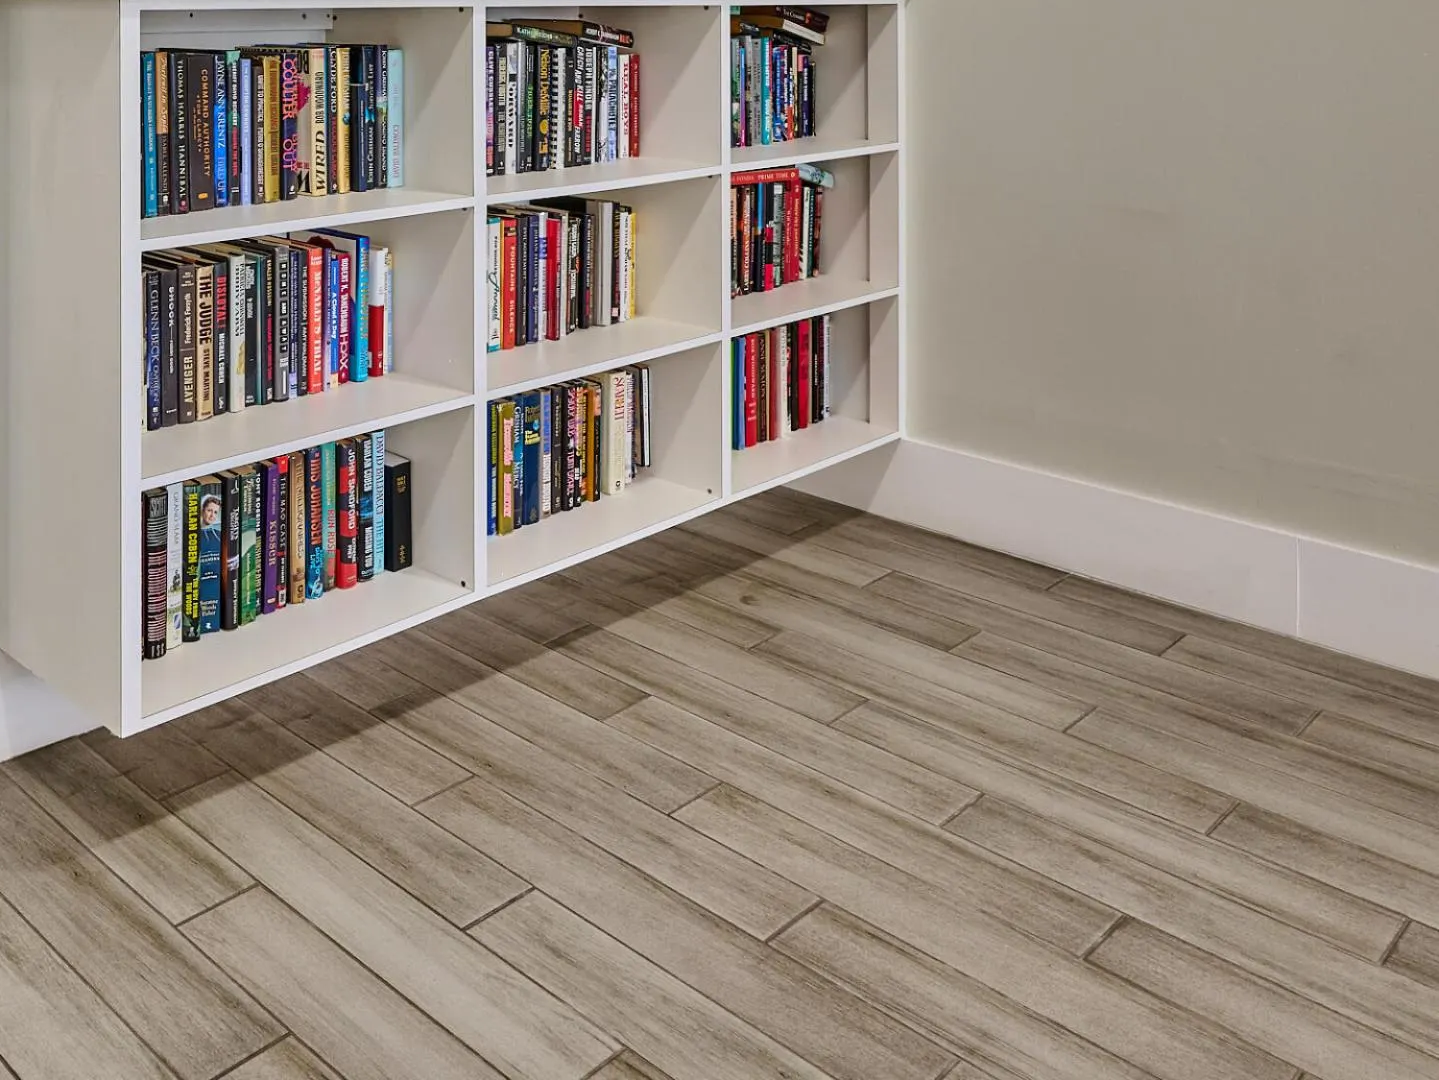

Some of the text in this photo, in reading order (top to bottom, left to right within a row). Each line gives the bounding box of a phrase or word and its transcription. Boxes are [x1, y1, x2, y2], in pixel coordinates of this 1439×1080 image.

[177, 59, 185, 99] THOMAS
[282, 59, 294, 120] COULTER
[315, 71, 324, 110] WOODWARD
[342, 51, 350, 109] JOHN GRISHAM
[540, 49, 550, 115] Nelson DeMille
[574, 46, 584, 102] CATCH AND KILL
[201, 69, 211, 177] COMMAND AUTHORITY
[217, 61, 226, 148] JAYNE ANN KRENTZ
[315, 111, 324, 124] BOB
[282, 138, 293, 170] OUT
[315, 130, 326, 191] WIRED
[366, 126, 374, 162] GRISHAM
[178, 144, 187, 198] HANNIBAL
[340, 258, 349, 283] ROBERT
[150, 289, 159, 331] GLENN
[184, 293, 192, 315] Forsyth
[199, 274, 213, 345] THE JUDGE
[216, 275, 226, 322] DISLOYAL
[151, 334, 160, 362] BECK
[313, 339, 322, 375] TRIAL
[340, 334, 349, 370] HOAX
[183, 356, 193, 403] AVENGER
[203, 371, 211, 402] MARTINI
[513, 406, 521, 443] GRISHAM
[347, 449, 356, 530] JOHN SANDFORD
[363, 440, 372, 492] HARLAN COBEN
[375, 435, 384, 515] DAVID BALDACCI
[310, 458, 321, 545] IRIS JOHANSEN
[188, 493, 198, 563] HARLAN COBEN
[268, 519, 277, 567] KISSER
[327, 531, 335, 555] ROSE
[364, 527, 372, 568] MISSING YOU
[375, 520, 384, 554] THE HIT
